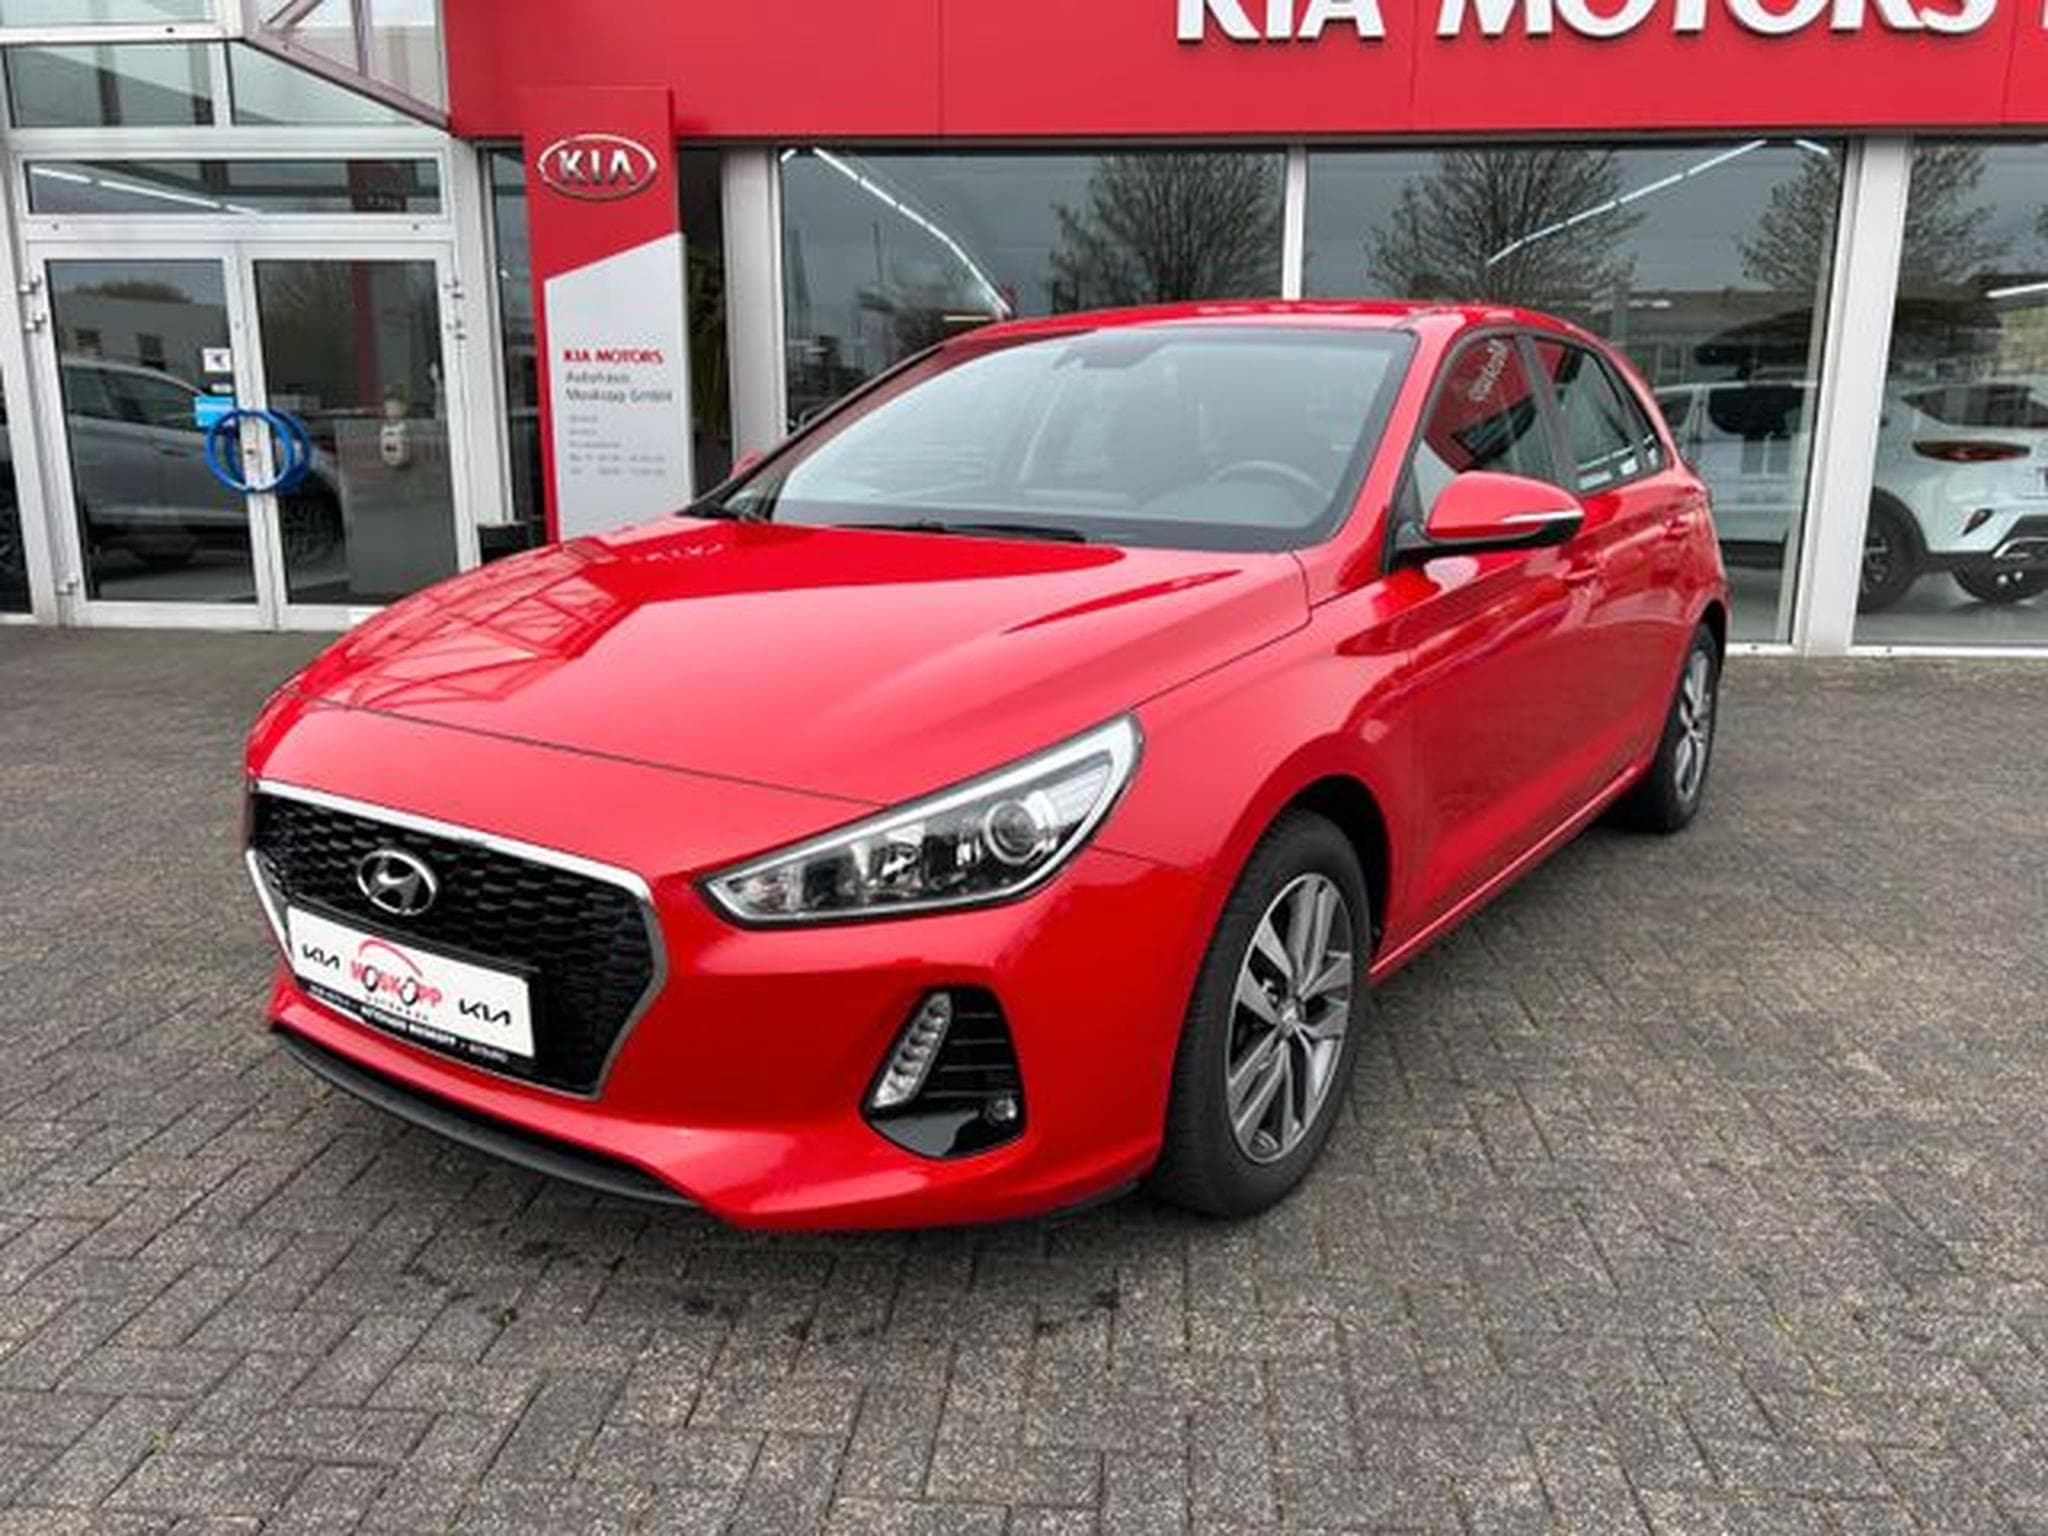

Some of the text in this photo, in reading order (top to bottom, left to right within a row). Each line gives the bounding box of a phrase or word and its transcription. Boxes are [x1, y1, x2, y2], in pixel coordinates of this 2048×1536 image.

[557, 149, 637, 185] KIA
[564, 349, 664, 365] KIA MOTORS
[458, 997, 512, 1027] KIA
